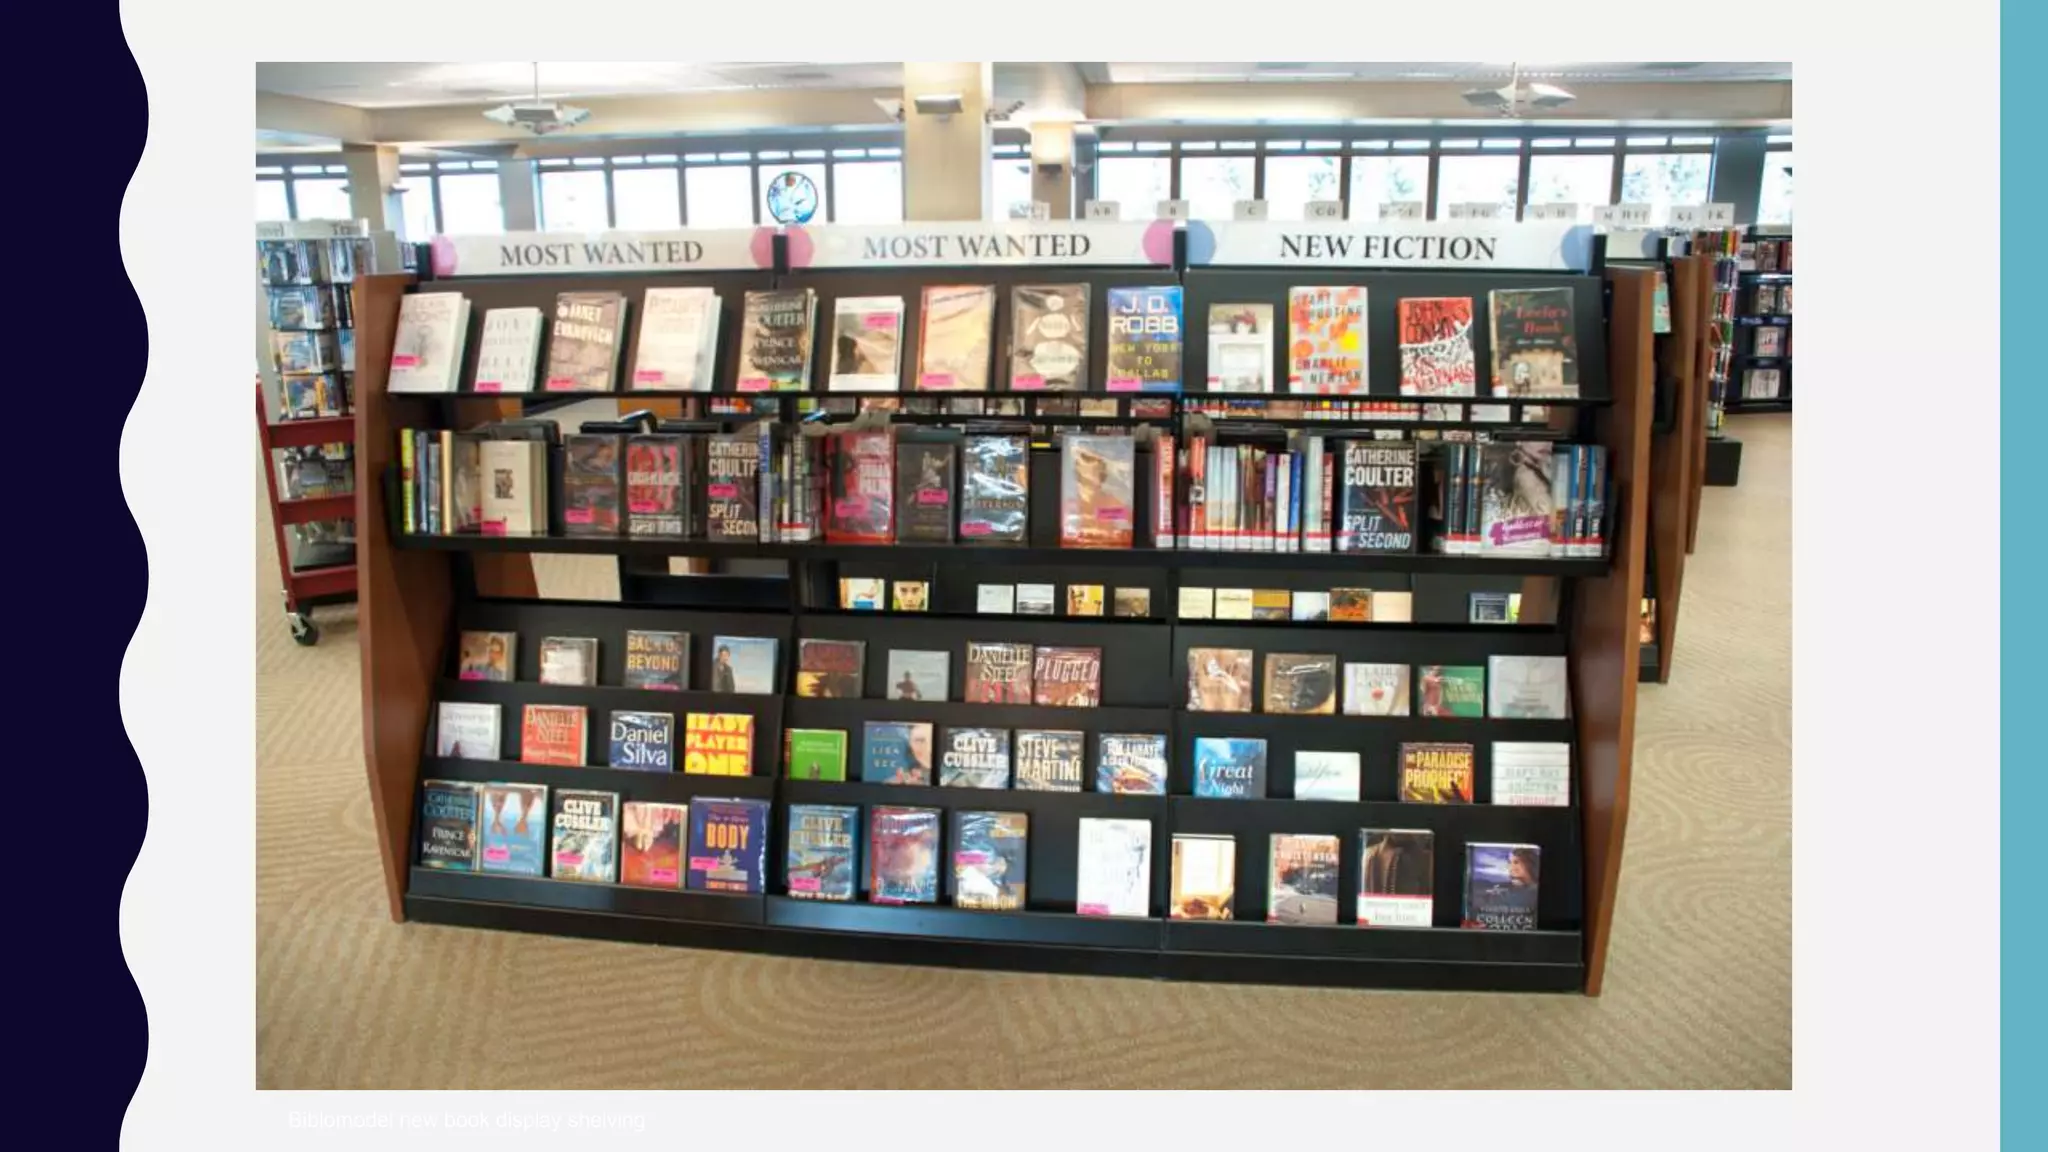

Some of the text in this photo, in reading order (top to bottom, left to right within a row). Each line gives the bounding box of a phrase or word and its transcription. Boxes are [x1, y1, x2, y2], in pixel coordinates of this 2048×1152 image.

[500, 240, 704, 267] MOST WANTED
[863, 233, 1091, 260] MOST WANTED
[1280, 234, 1497, 262] NEW FICTION
[1121, 295, 1141, 314] J.
[1110, 315, 1179, 335] ROBB
[1345, 449, 1414, 467] CATHERINE
[1344, 467, 1414, 487] COULTER
[708, 503, 741, 519] SPLIT
[722, 519, 758, 536] SECON
[1345, 515, 1383, 532] SPLIT
[1358, 532, 1412, 549] SECOND
[627, 653, 680, 673] BEYOND
[968, 648, 1031, 665] DANIELLE
[980, 664, 1019, 683] STEEL
[1034, 655, 1100, 683] PLUGGED
[611, 722, 668, 744] Daniel
[686, 733, 748, 751] PLAYER
[953, 736, 997, 753] CLIVE
[1018, 738, 1058, 760] STEVE
[622, 743, 668, 766] Silva
[685, 752, 750, 775] ONE
[1416, 750, 1473, 769] PARADISE
[1017, 758, 1081, 781] MARTINI
[563, 799, 602, 815] CLIVE
[555, 814, 612, 832] CUSSLER
[706, 822, 750, 851] BODY
